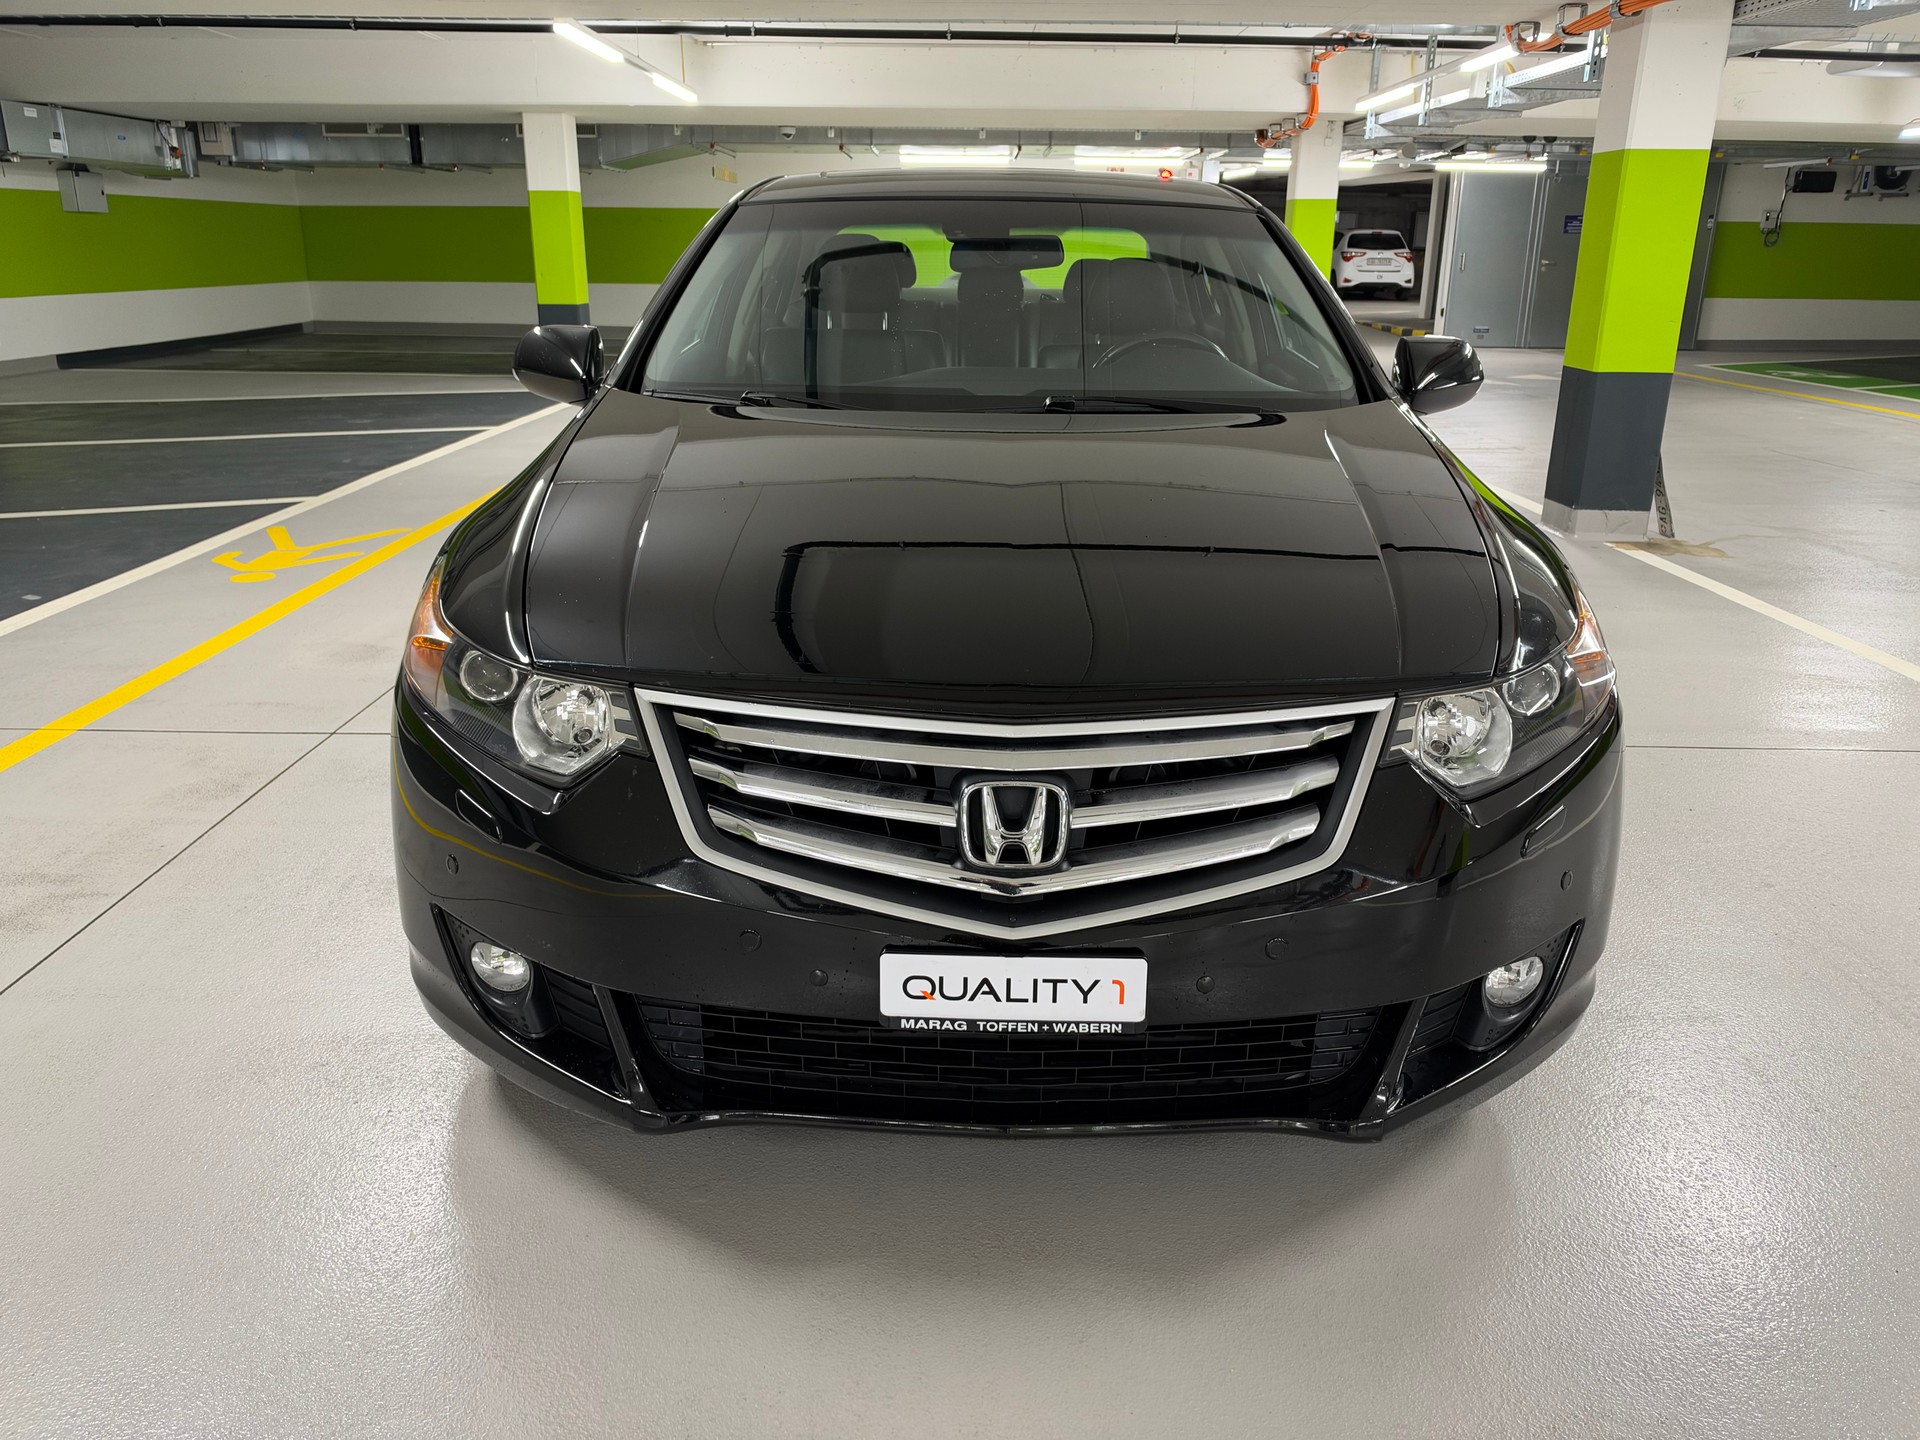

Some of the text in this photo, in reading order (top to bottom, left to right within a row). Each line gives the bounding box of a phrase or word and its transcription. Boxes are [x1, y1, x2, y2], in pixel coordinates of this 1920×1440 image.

[902, 975, 1125, 1004] QUALITY 1
[900, 1018, 967, 1031] MARAG
[976, 1021, 1039, 1032] TOFFEN
[1052, 1023, 1122, 1034] WABERN
